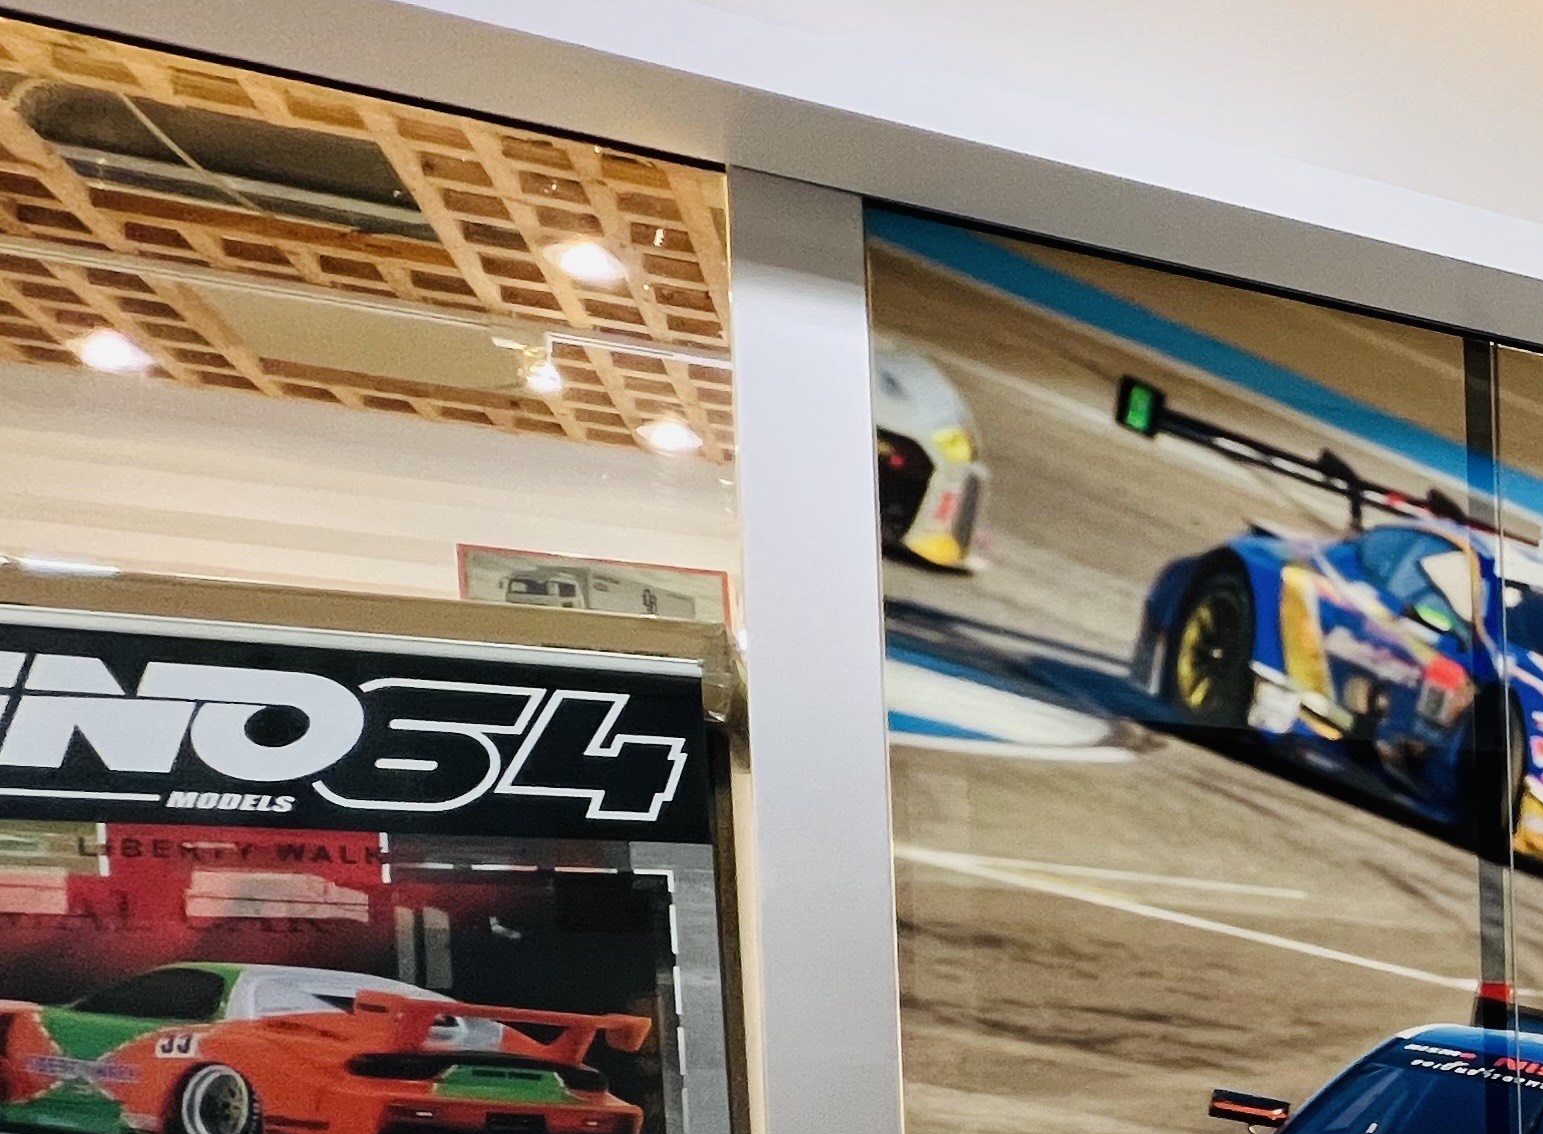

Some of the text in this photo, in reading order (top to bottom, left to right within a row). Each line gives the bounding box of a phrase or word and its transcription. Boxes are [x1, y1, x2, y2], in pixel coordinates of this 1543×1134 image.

[0, 651, 687, 822] NO64
[166, 790, 295, 813] MODELS
[78, 836, 254, 862] LBERTY
